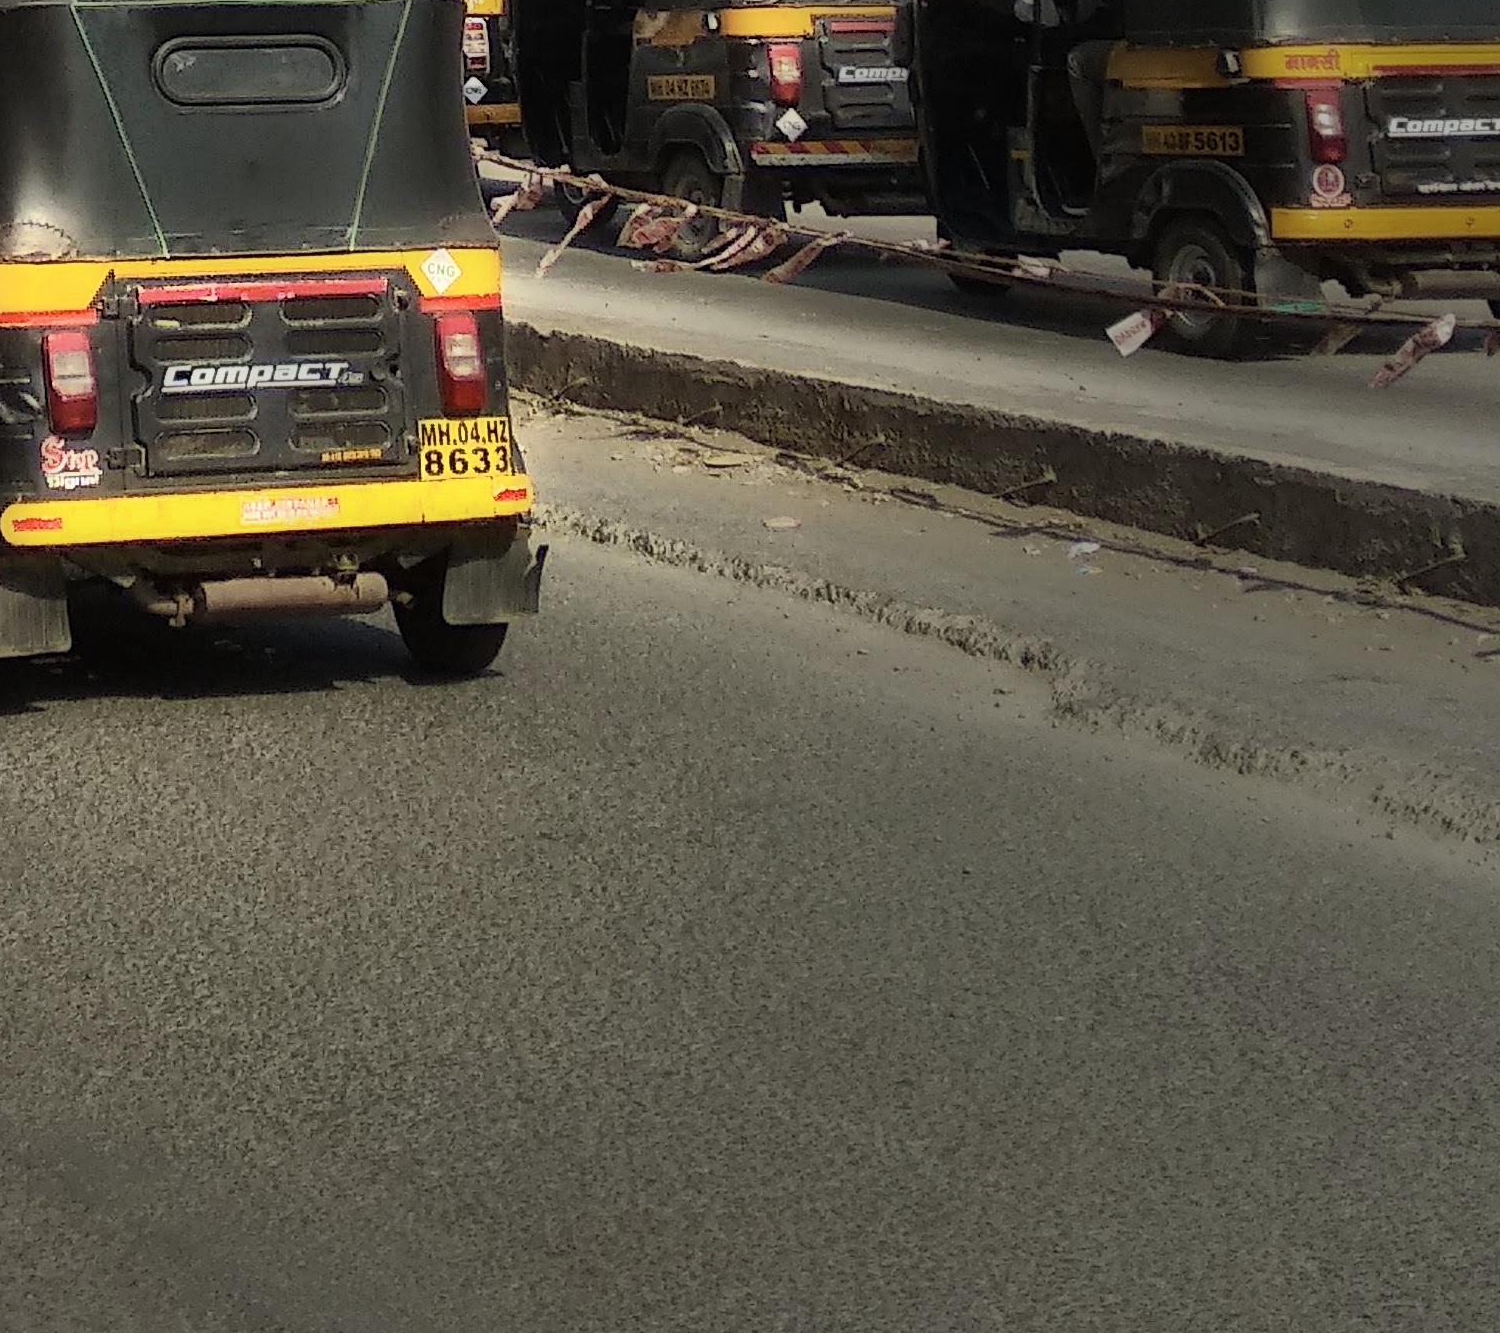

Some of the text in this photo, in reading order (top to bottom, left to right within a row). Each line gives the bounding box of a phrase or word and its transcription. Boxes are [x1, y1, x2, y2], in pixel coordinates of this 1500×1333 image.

[427, 262, 456, 278] CNG
[421, 419, 508, 446] MH.04.HZ
[424, 446, 509, 476] 8633
